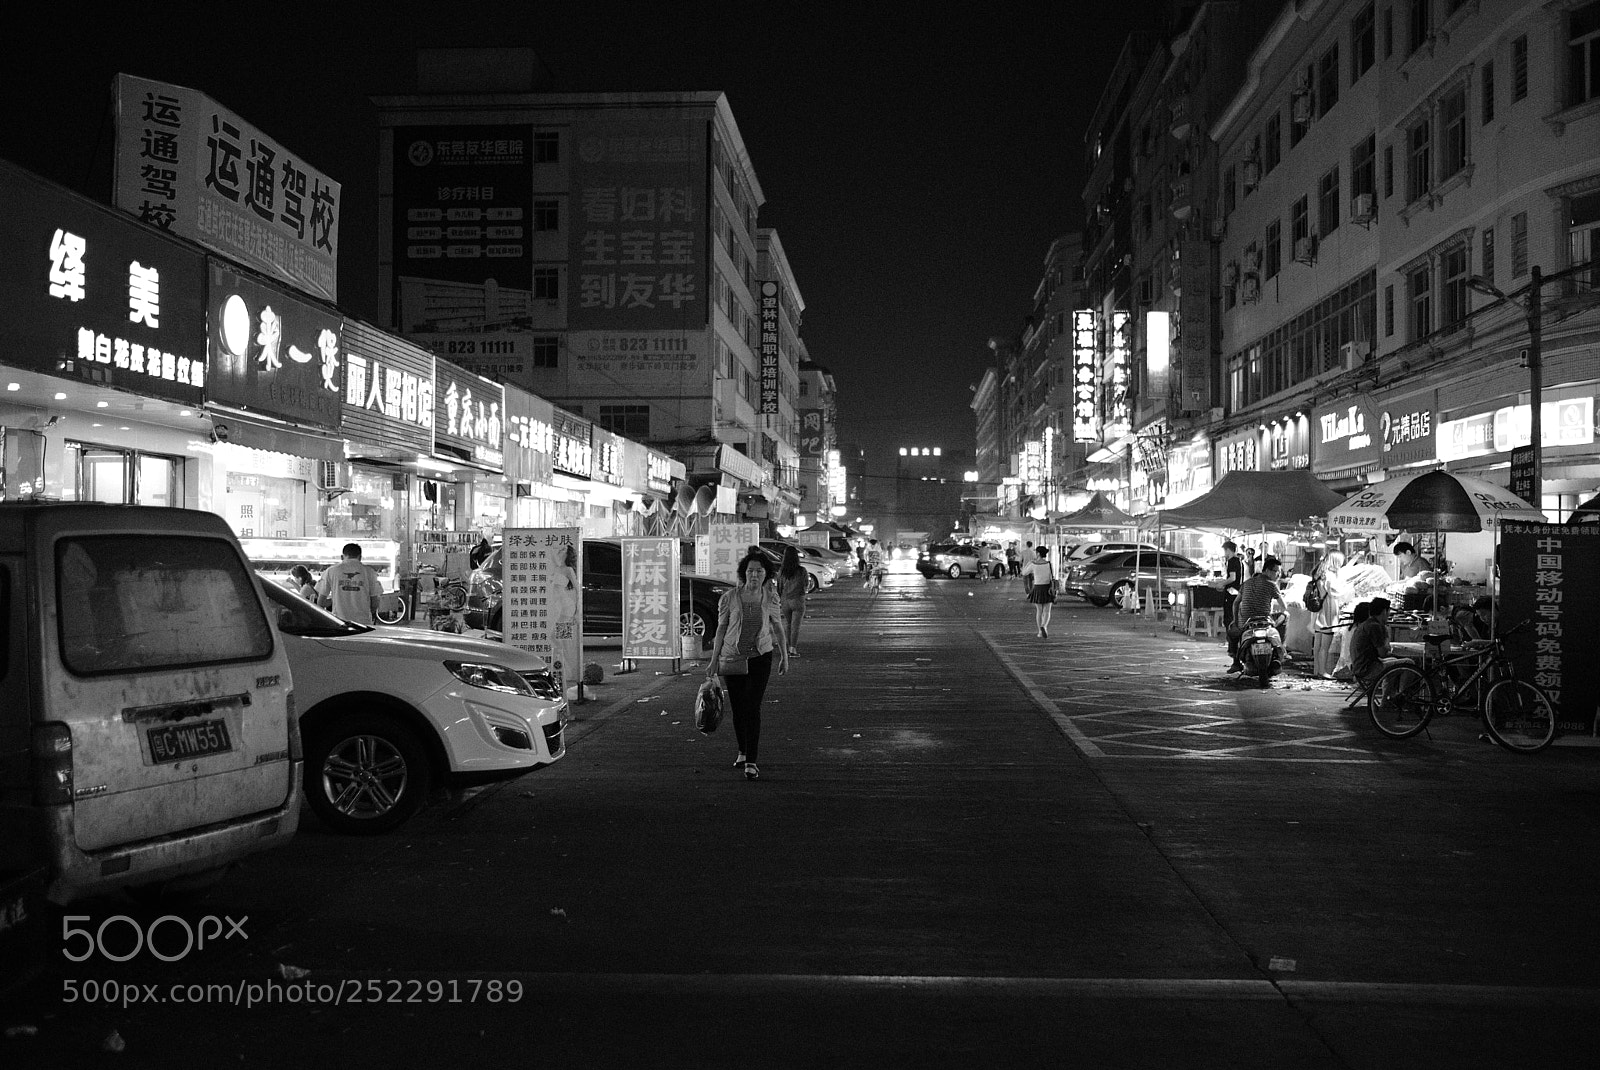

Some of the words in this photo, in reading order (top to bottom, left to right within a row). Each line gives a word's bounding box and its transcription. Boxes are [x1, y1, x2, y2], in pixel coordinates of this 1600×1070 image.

[139, 93, 182, 236] 运通驾校
[437, 139, 524, 156] 东莞友华医院
[205, 114, 335, 256] 运通驾校
[438, 186, 495, 201] 诊疗科目
[582, 186, 696, 223] 看妇科
[580, 229, 696, 266] 生宝宝
[580, 272, 696, 309] 到友华
[449, 341, 476, 354] 823
[480, 341, 515, 354] 11111
[620, 338, 648, 351] 823
[653, 338, 688, 351] 11111
[762, 298, 778, 413] 望林电脑职业培训学校
[347, 353, 433, 428] 丽人照相馆
[802, 412, 823, 455] 网吧
[626, 542, 671, 558] 来一煲
[628, 559, 670, 645] 麻辣烫
